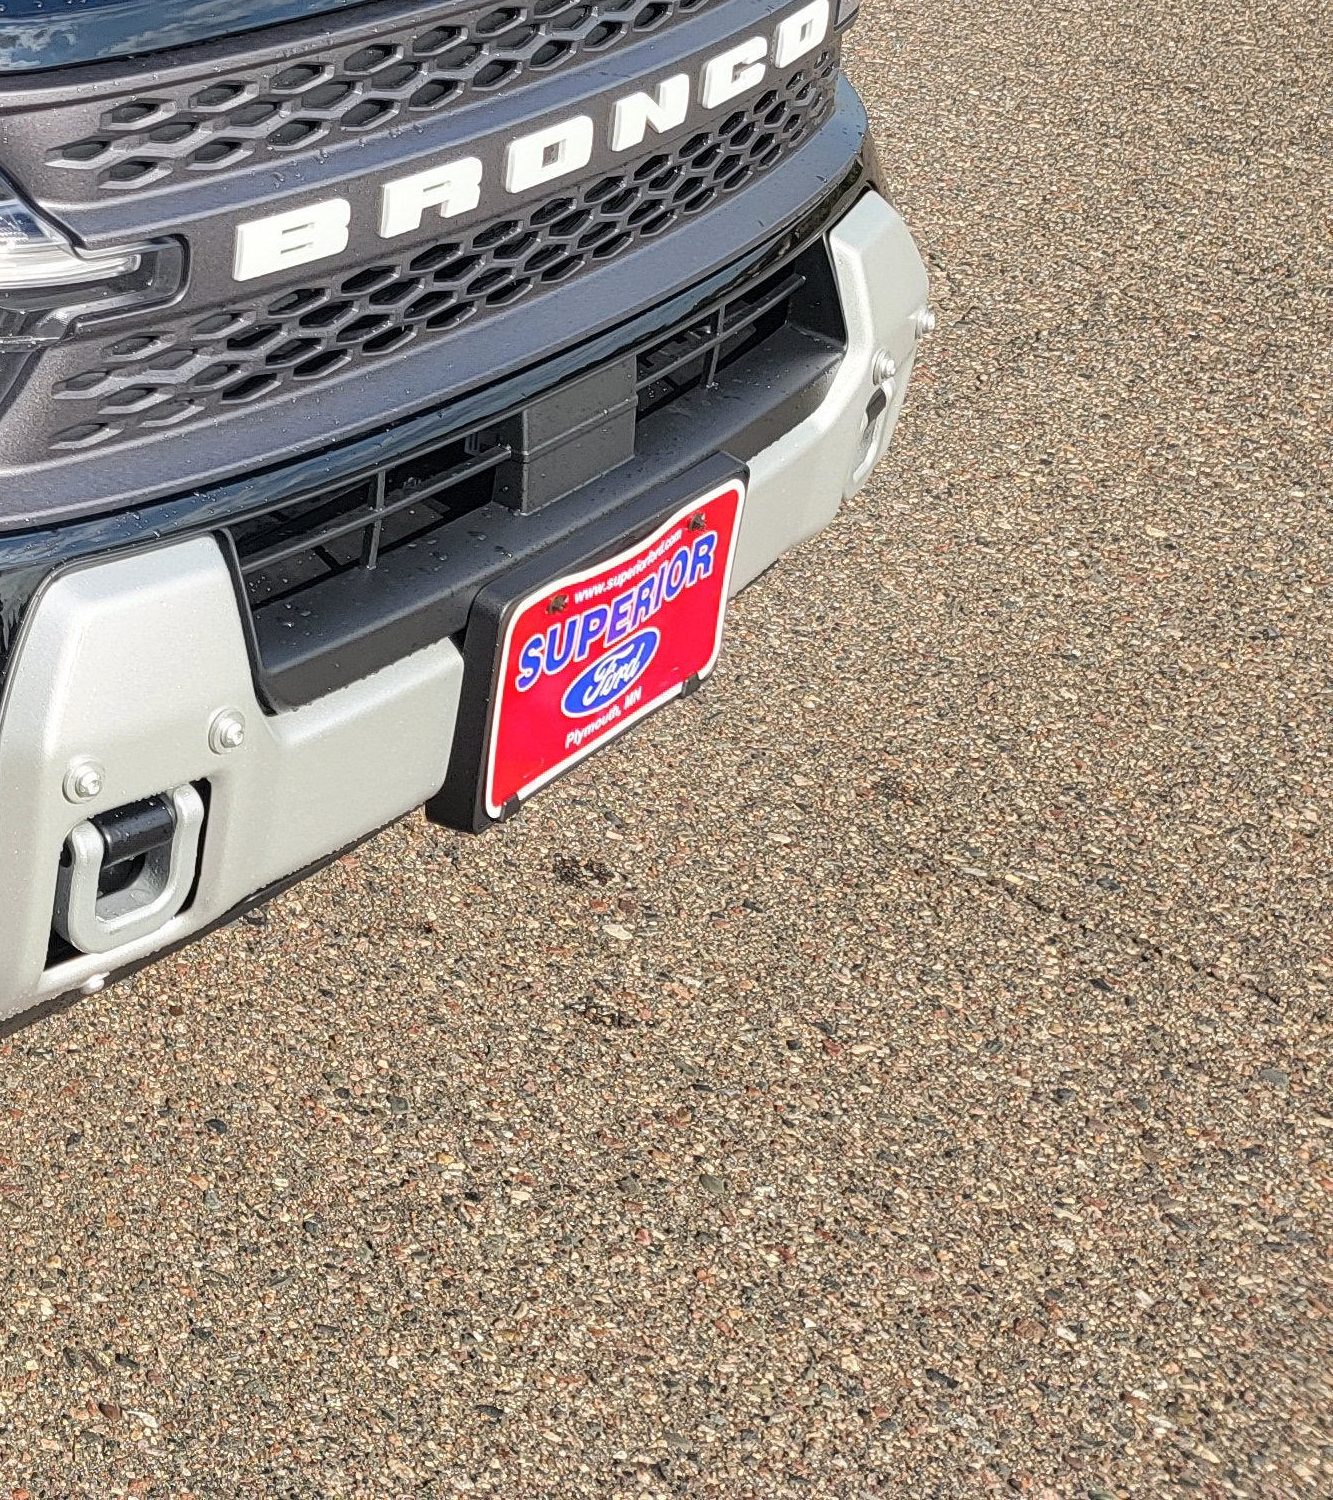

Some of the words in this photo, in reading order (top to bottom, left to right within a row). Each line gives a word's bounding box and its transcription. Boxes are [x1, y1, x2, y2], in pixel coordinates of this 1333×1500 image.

[574, 528, 683, 603] www.superiorford.com
[515, 531, 718, 692] SUPERIOR
[581, 642, 646, 706] Ford
[564, 704, 622, 749] Plymouth,
[623, 685, 643, 710] MN
